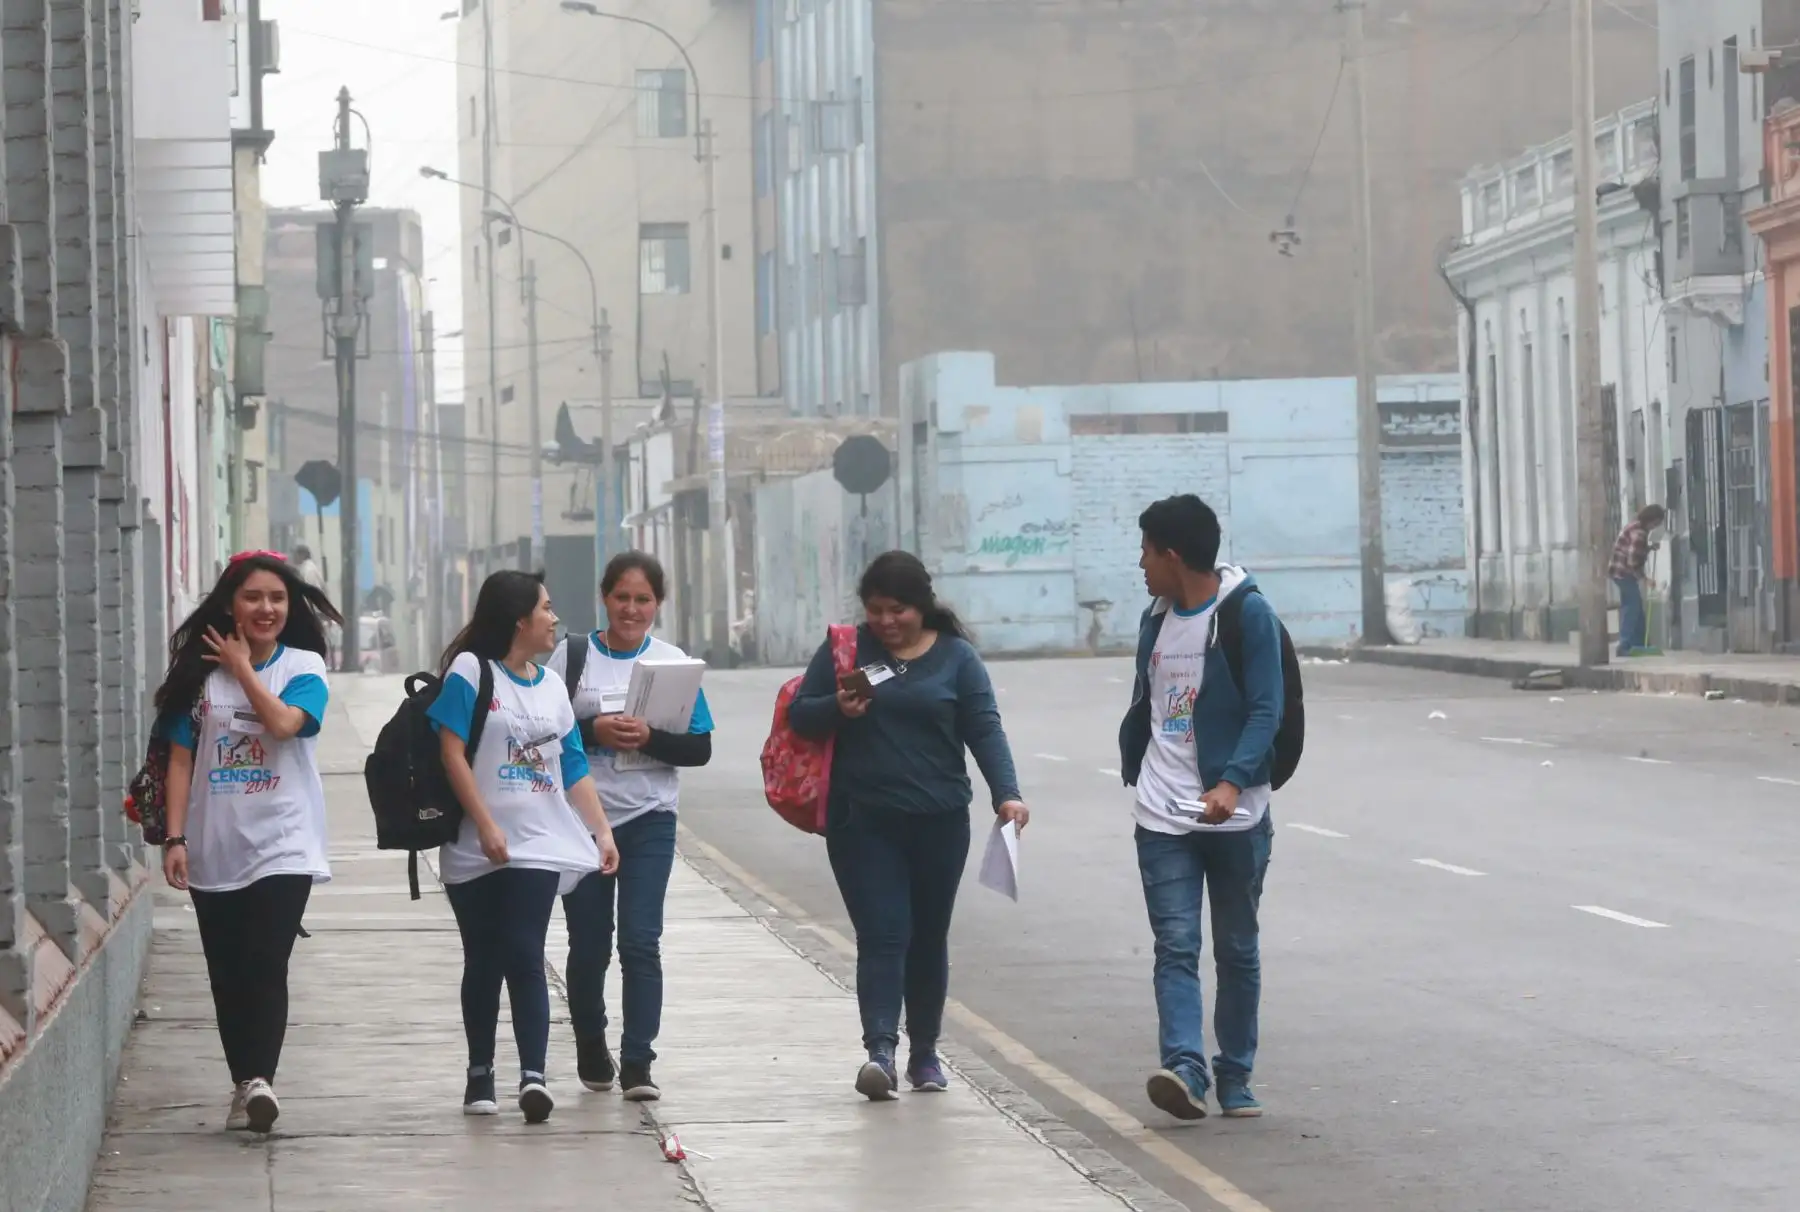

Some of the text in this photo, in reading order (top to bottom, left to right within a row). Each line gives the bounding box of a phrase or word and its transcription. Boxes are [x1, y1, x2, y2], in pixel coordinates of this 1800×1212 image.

[1162, 718, 1192, 733] CENS
[208, 769, 272, 783] CENSOS
[244, 776, 281, 795] 2017
